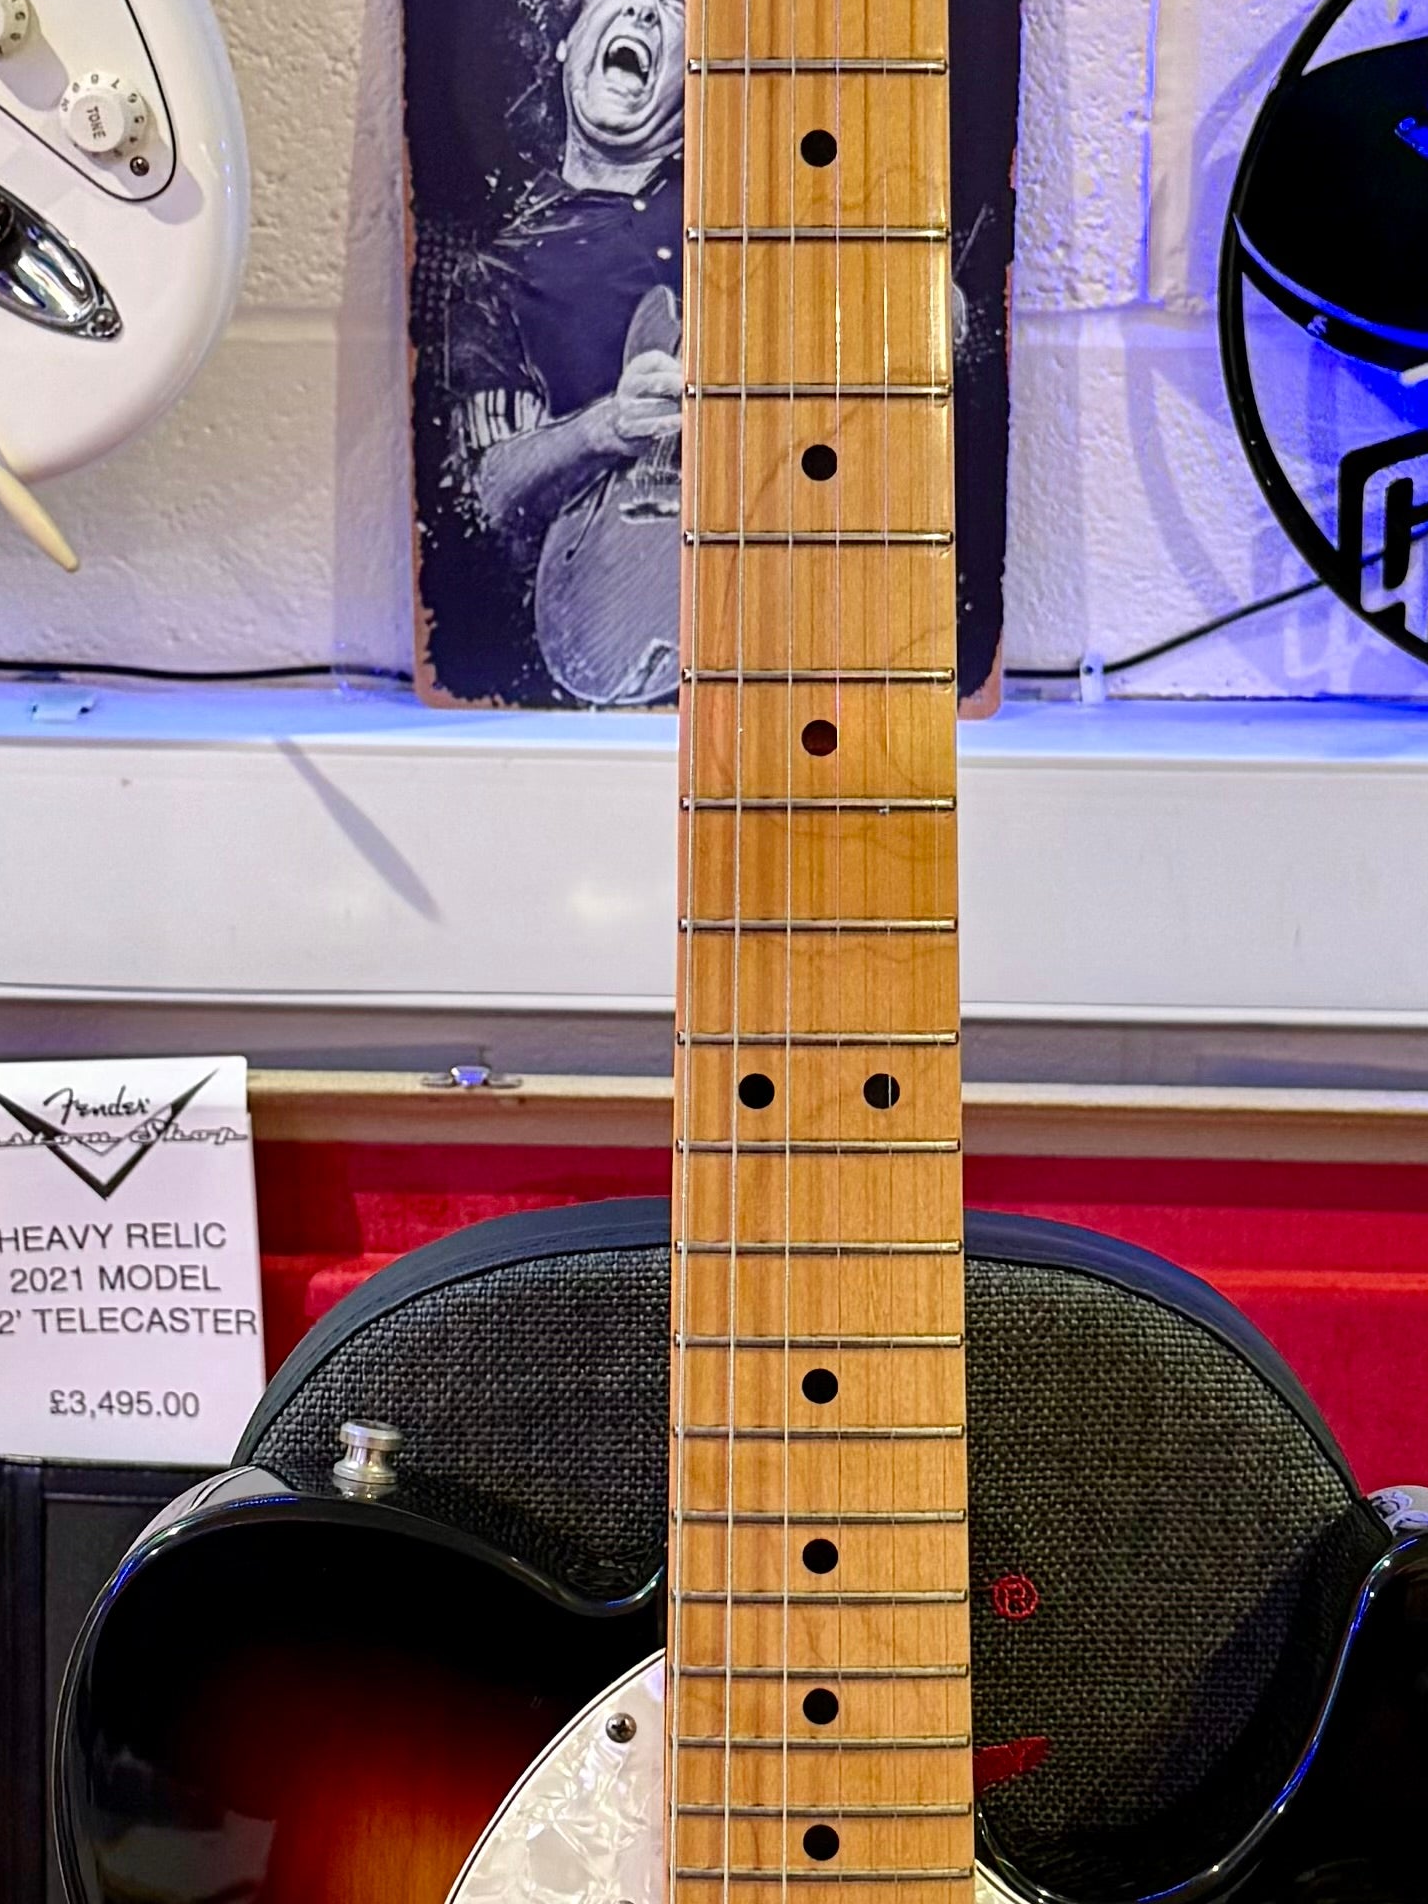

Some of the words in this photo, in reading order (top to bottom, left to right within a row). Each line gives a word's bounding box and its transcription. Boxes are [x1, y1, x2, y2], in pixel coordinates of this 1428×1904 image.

[85, 106, 107, 139] TONE
[43, 1085, 148, 1125] Fender
[128, 1118, 248, 1146] Shop
[126, 1222, 227, 1249] RELIC
[9, 1267, 83, 1295] 2021
[99, 1264, 221, 1292] MODEL
[32, 1306, 258, 1336] TELECASTER
[49, 1389, 200, 1419] £3,495.00
